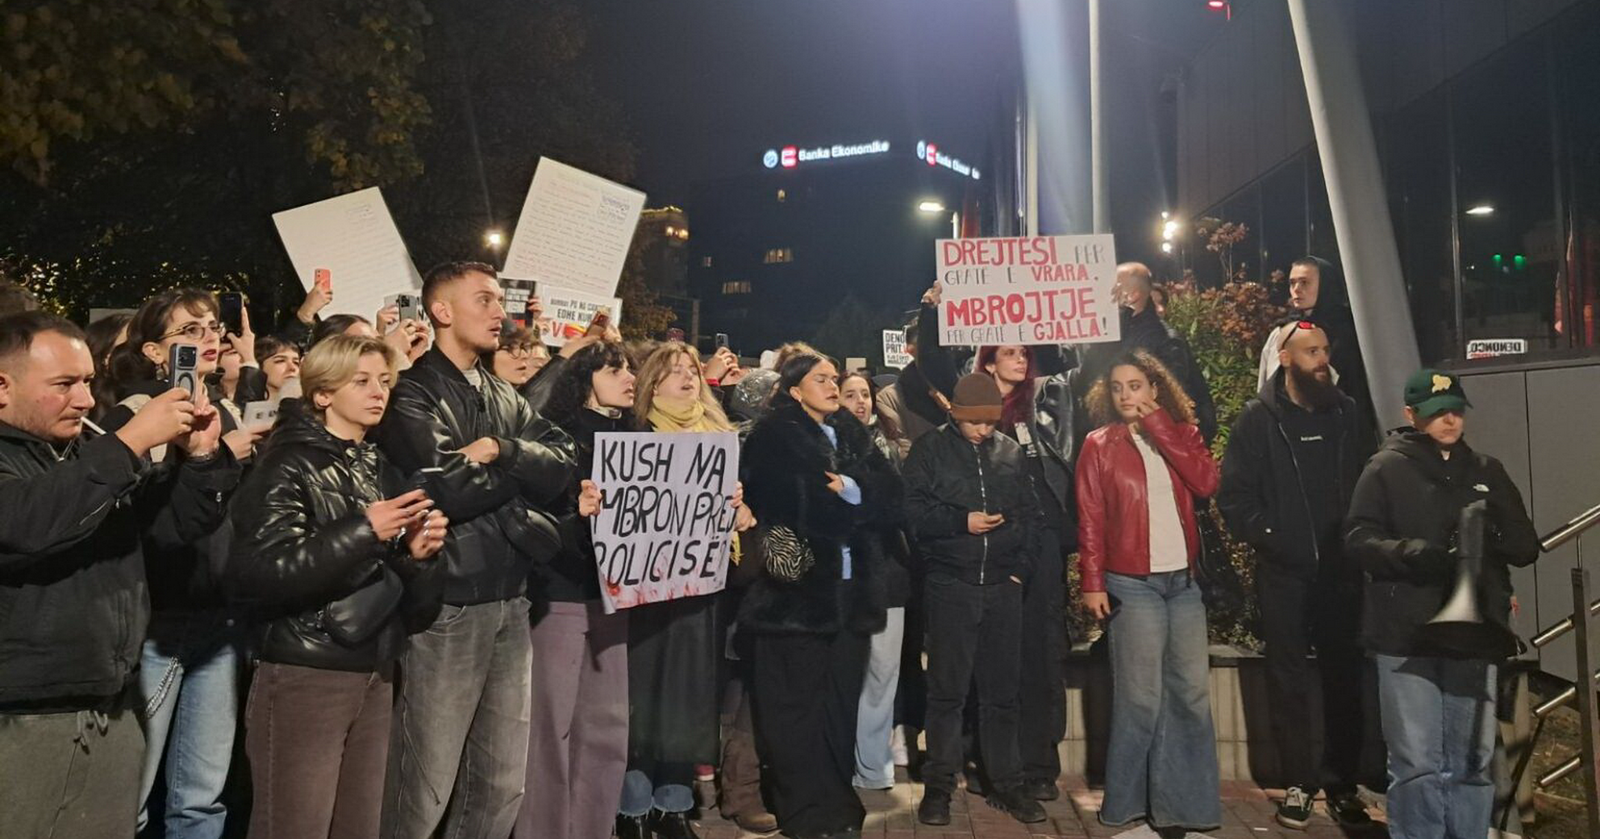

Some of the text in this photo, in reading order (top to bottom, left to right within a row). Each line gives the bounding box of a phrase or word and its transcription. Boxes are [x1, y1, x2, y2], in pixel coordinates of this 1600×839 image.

[798, 147, 830, 161] Banka
[1074, 244, 1107, 264] PER
[557, 308, 576, 321] EDHE
[946, 287, 1097, 327] MBROJTJE
[885, 333, 906, 343] DENO
[1034, 317, 1108, 341] GJALLA!
[885, 344, 902, 354] PRIT
[602, 439, 726, 495] KUSH NA
[594, 485, 690, 537] MBRON
